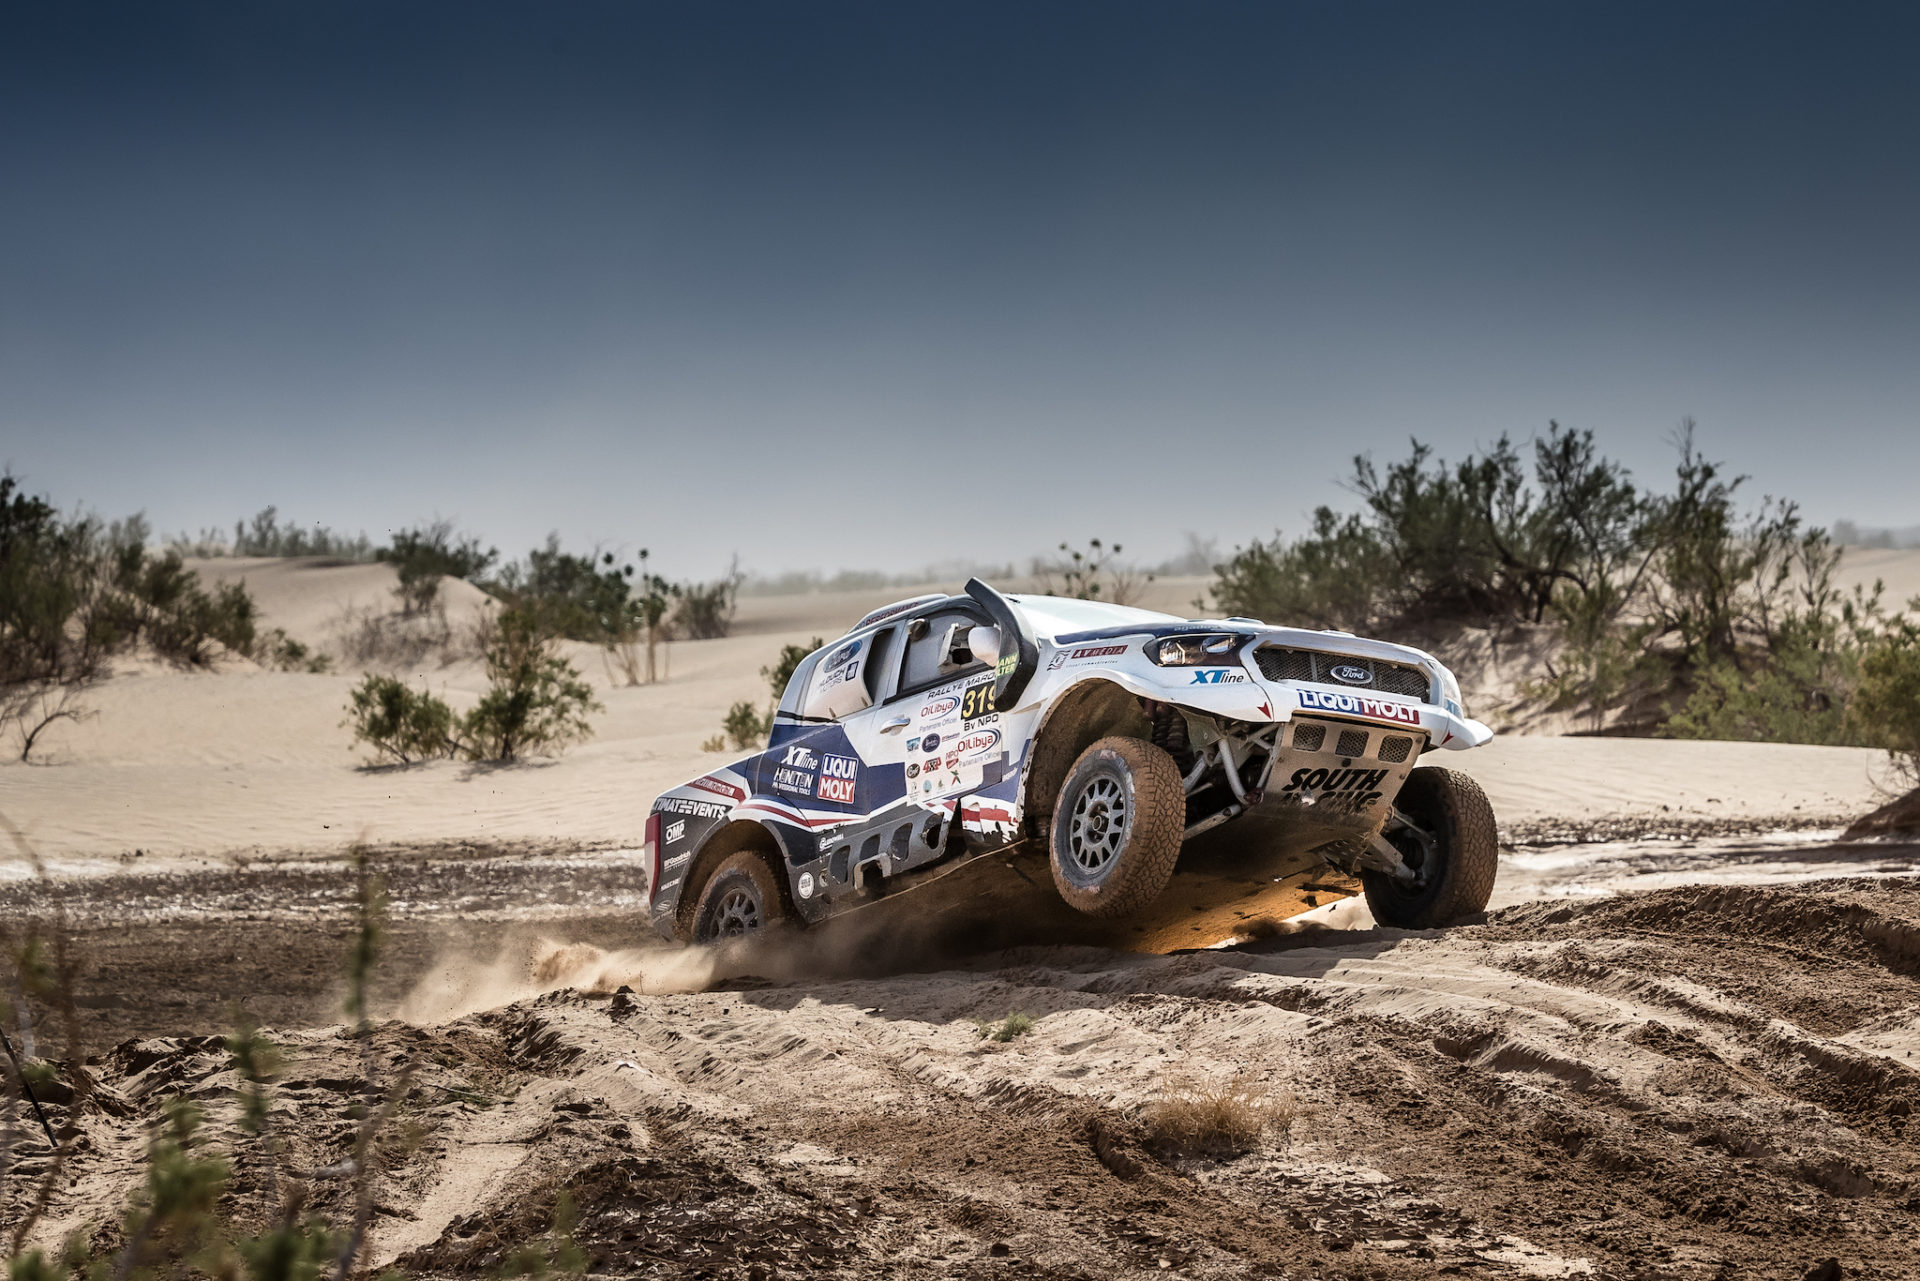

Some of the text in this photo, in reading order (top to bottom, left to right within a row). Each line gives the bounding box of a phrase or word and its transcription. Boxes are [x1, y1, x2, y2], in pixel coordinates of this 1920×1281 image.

[927, 671, 996, 700] RALLYE MARO
[1190, 669, 1245, 685] XTline
[1341, 667, 1365, 681] Ford
[1300, 690, 1416, 722] LIQUI MOLY
[977, 714, 999, 727] NPO
[957, 735, 994, 753] OiLibya
[781, 745, 819, 771] XTline
[822, 756, 857, 780] LIQUI
[819, 777, 854, 801] MOLY
[1281, 768, 1390, 792] SOUTH
[665, 823, 686, 841] OMP
